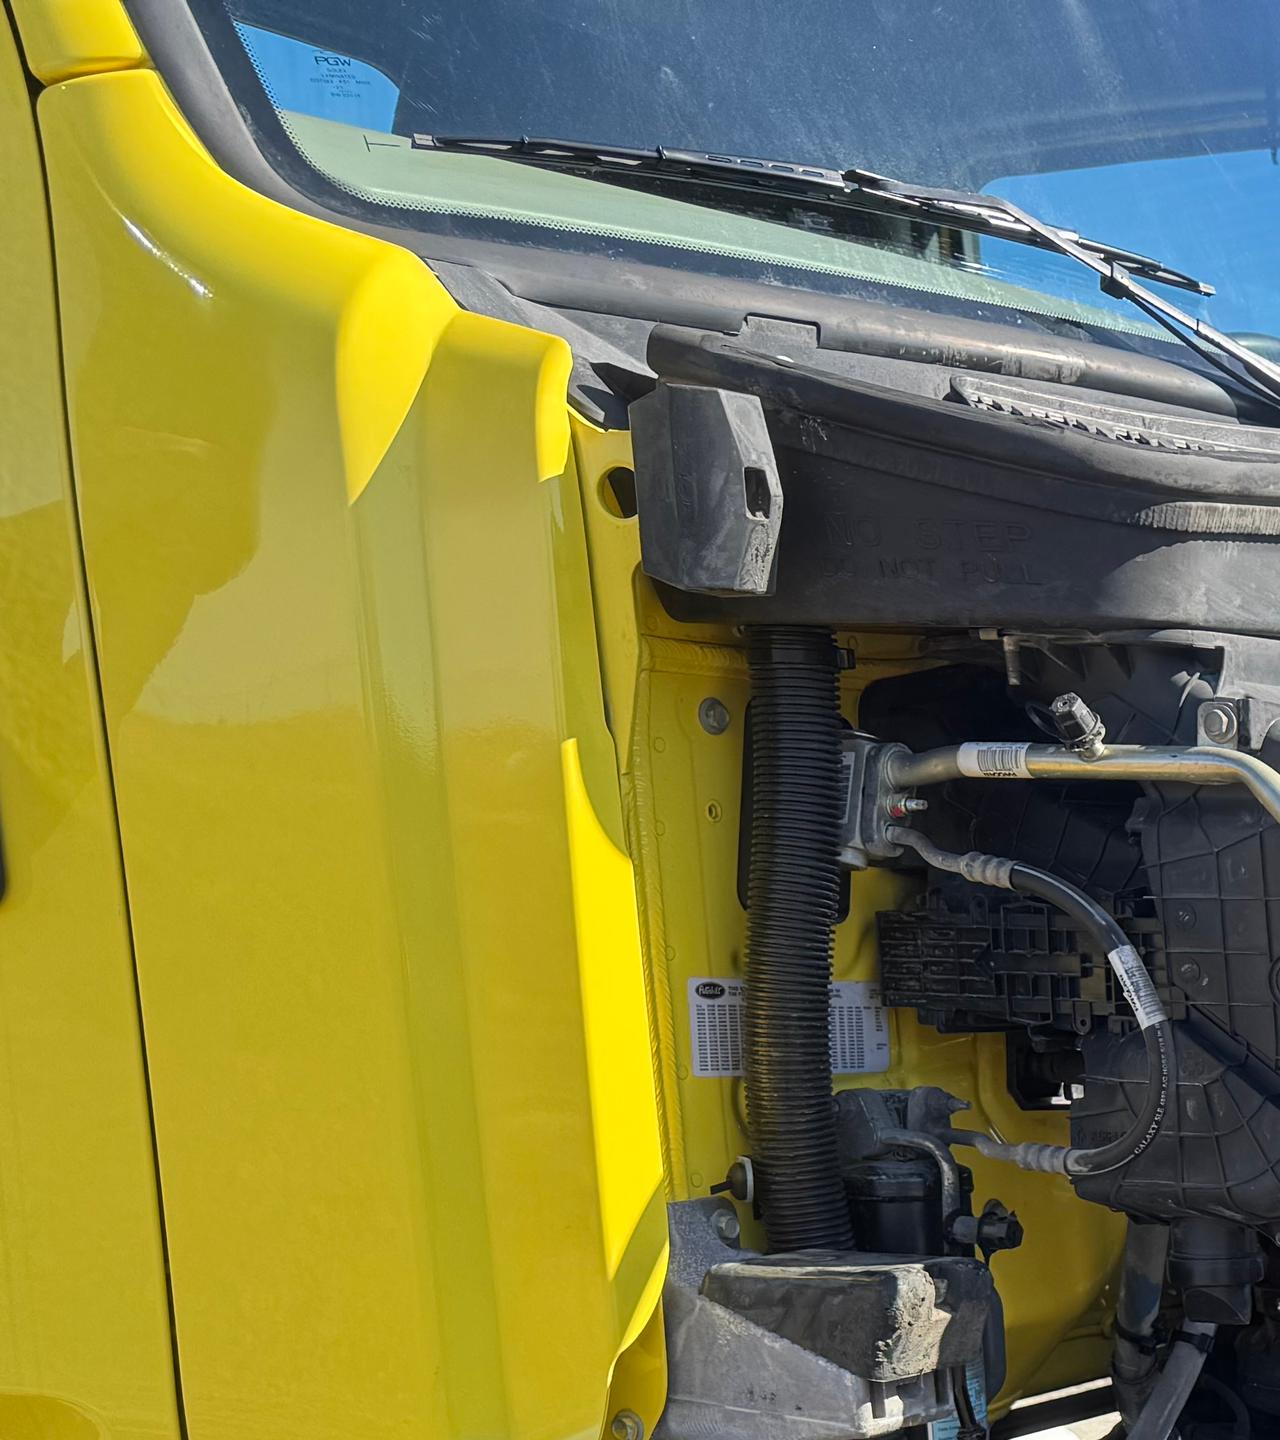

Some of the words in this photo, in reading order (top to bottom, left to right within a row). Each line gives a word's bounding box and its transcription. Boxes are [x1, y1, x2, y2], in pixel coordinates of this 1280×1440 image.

[314, 56, 351, 67] PGW
[824, 514, 881, 549] NO
[915, 518, 1033, 552] STEP
[878, 558, 936, 579] NOT
